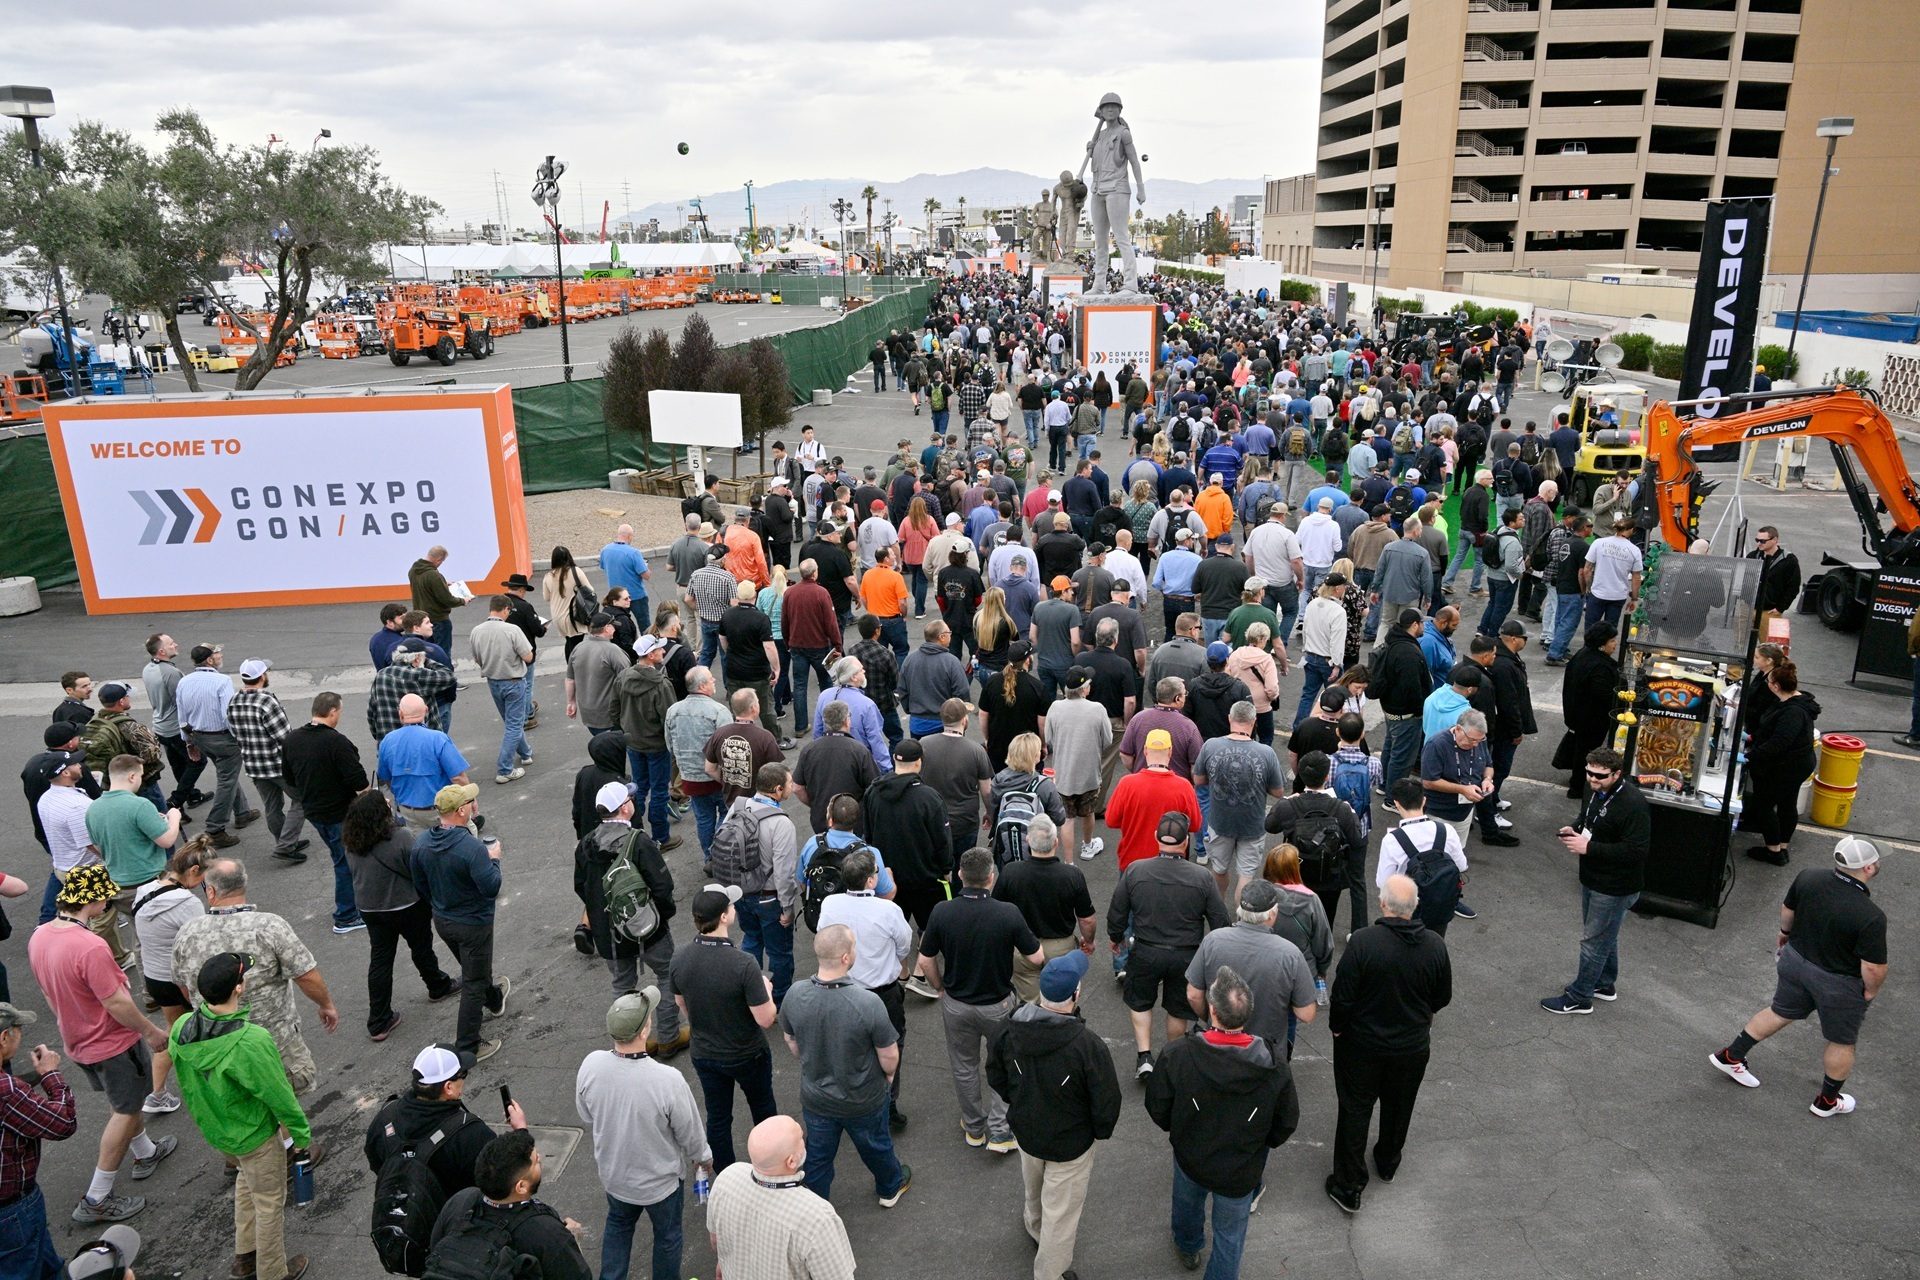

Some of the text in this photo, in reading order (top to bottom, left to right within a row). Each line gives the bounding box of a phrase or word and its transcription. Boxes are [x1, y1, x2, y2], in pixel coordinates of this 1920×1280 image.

[1753, 420, 1806, 436] DEVELON
[90, 438, 241, 459] WELCOME TO
[693, 459, 700, 469] 5
[230, 479, 436, 510] CONEXPO
[1648, 708, 1697, 720] SOFT PRETZELS
